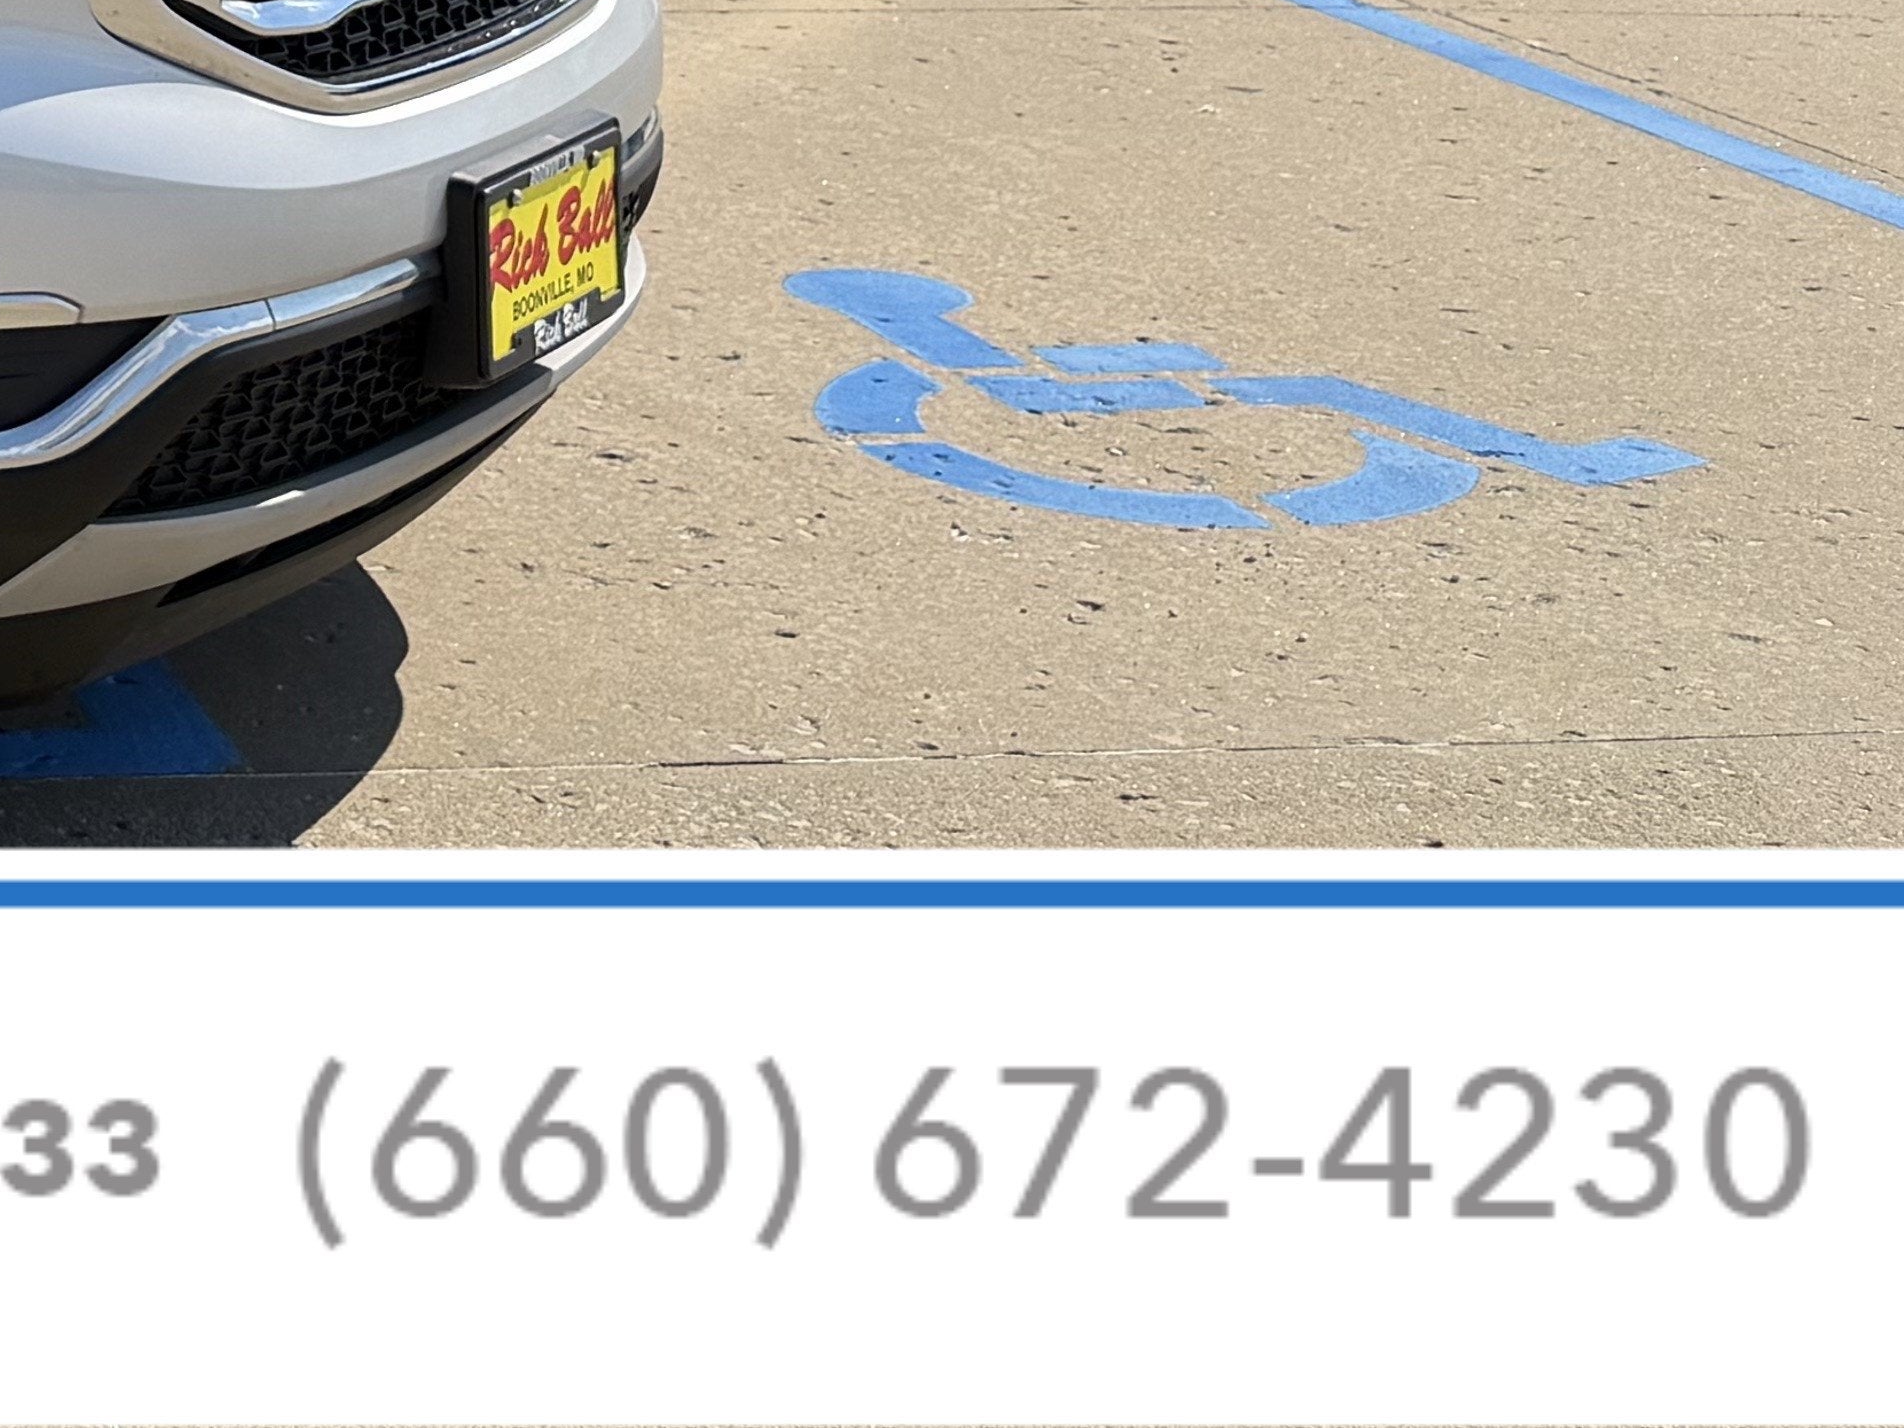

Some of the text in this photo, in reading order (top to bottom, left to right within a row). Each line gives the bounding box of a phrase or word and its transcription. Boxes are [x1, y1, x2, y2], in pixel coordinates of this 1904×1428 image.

[489, 176, 616, 293] Rick Ball
[512, 261, 594, 322] BOONVILLE, MO
